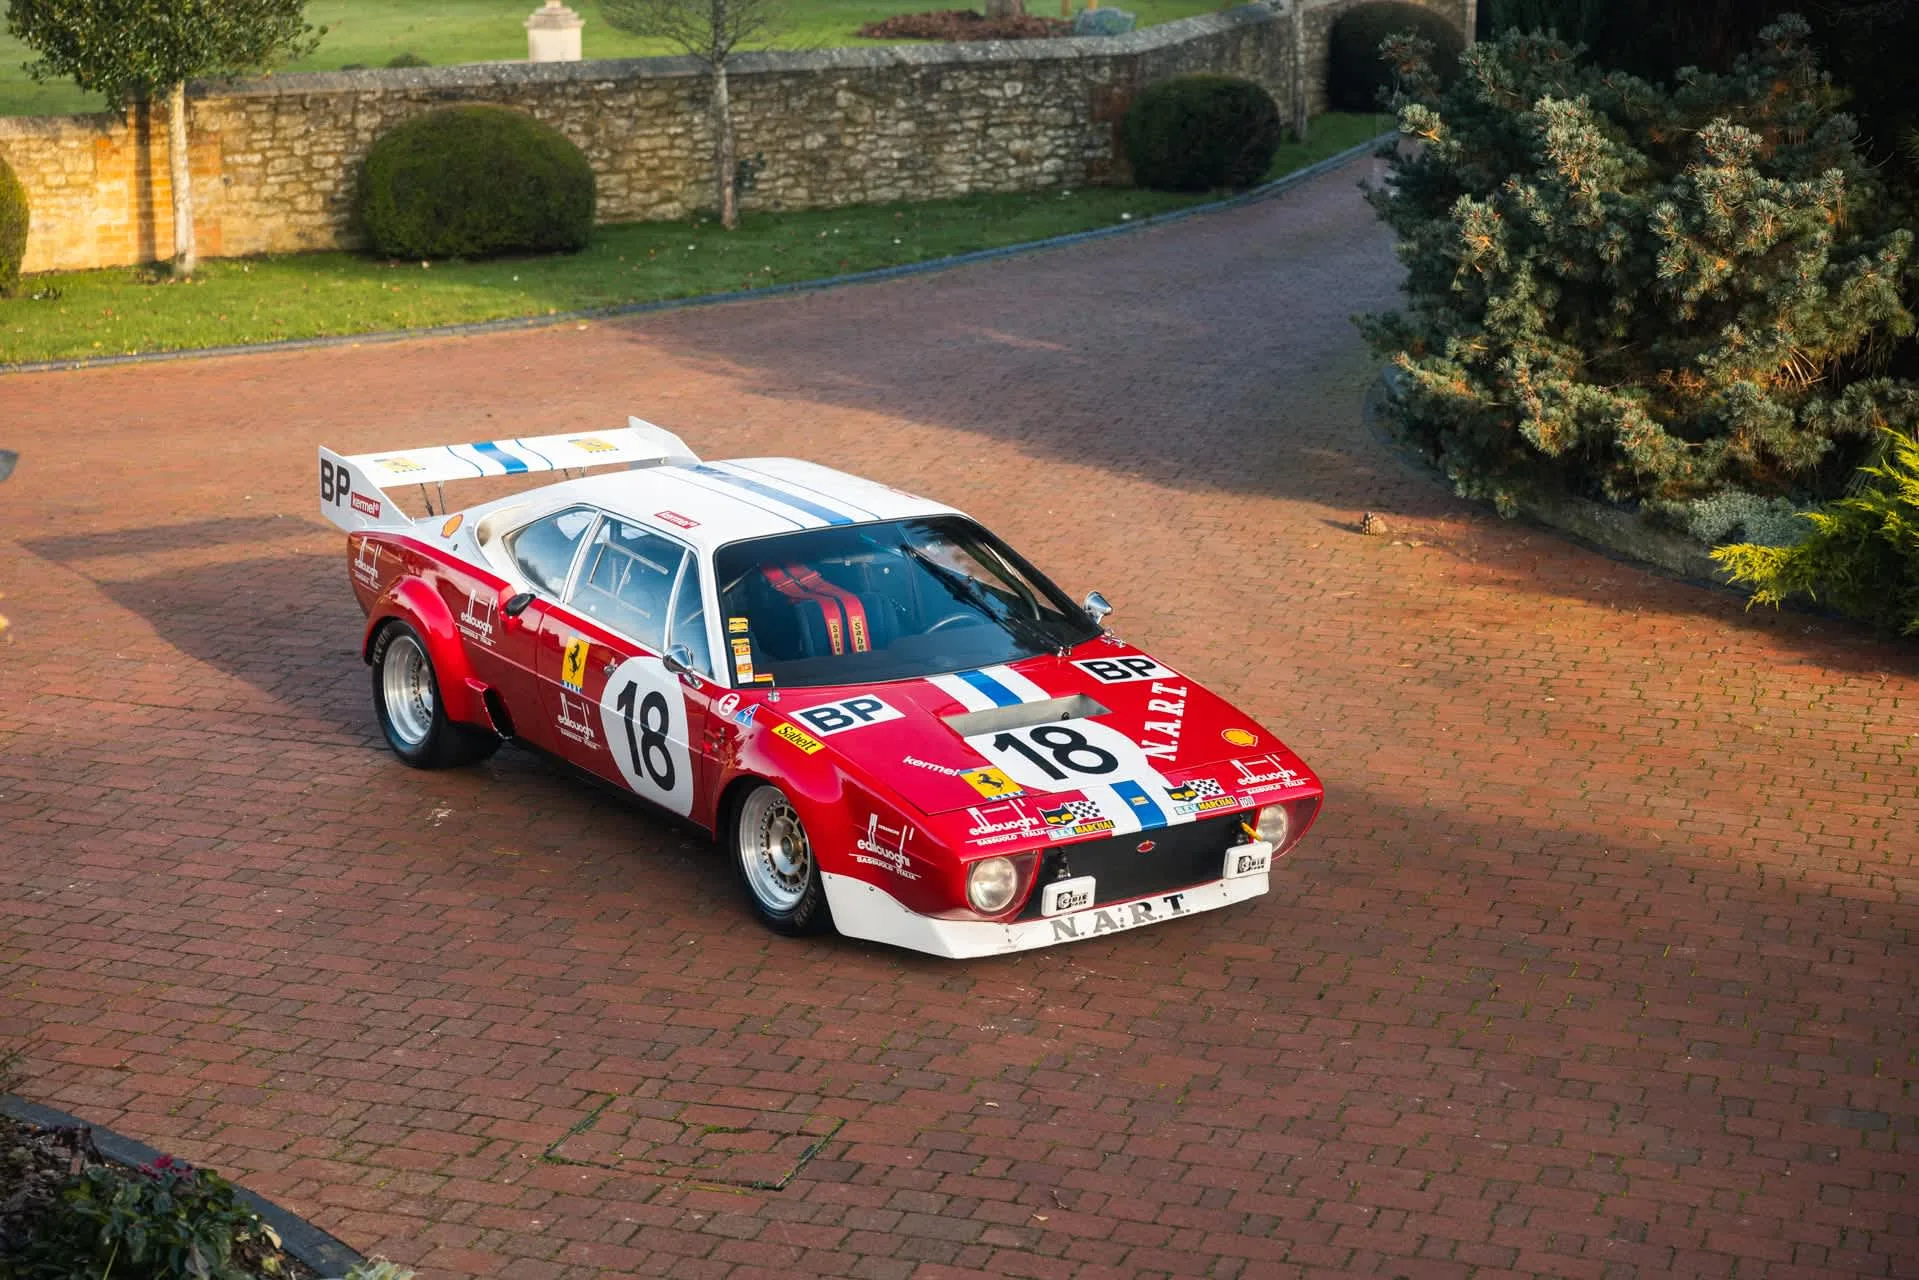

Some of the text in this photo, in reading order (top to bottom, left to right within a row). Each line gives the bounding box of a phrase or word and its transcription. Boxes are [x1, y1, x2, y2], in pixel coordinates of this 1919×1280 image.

[320, 457, 351, 508] BP
[1081, 658, 1156, 680] BP
[617, 681, 675, 791] 18
[799, 699, 883, 732] BP
[778, 725, 817, 751] Sabelt
[993, 725, 1119, 781] 18
